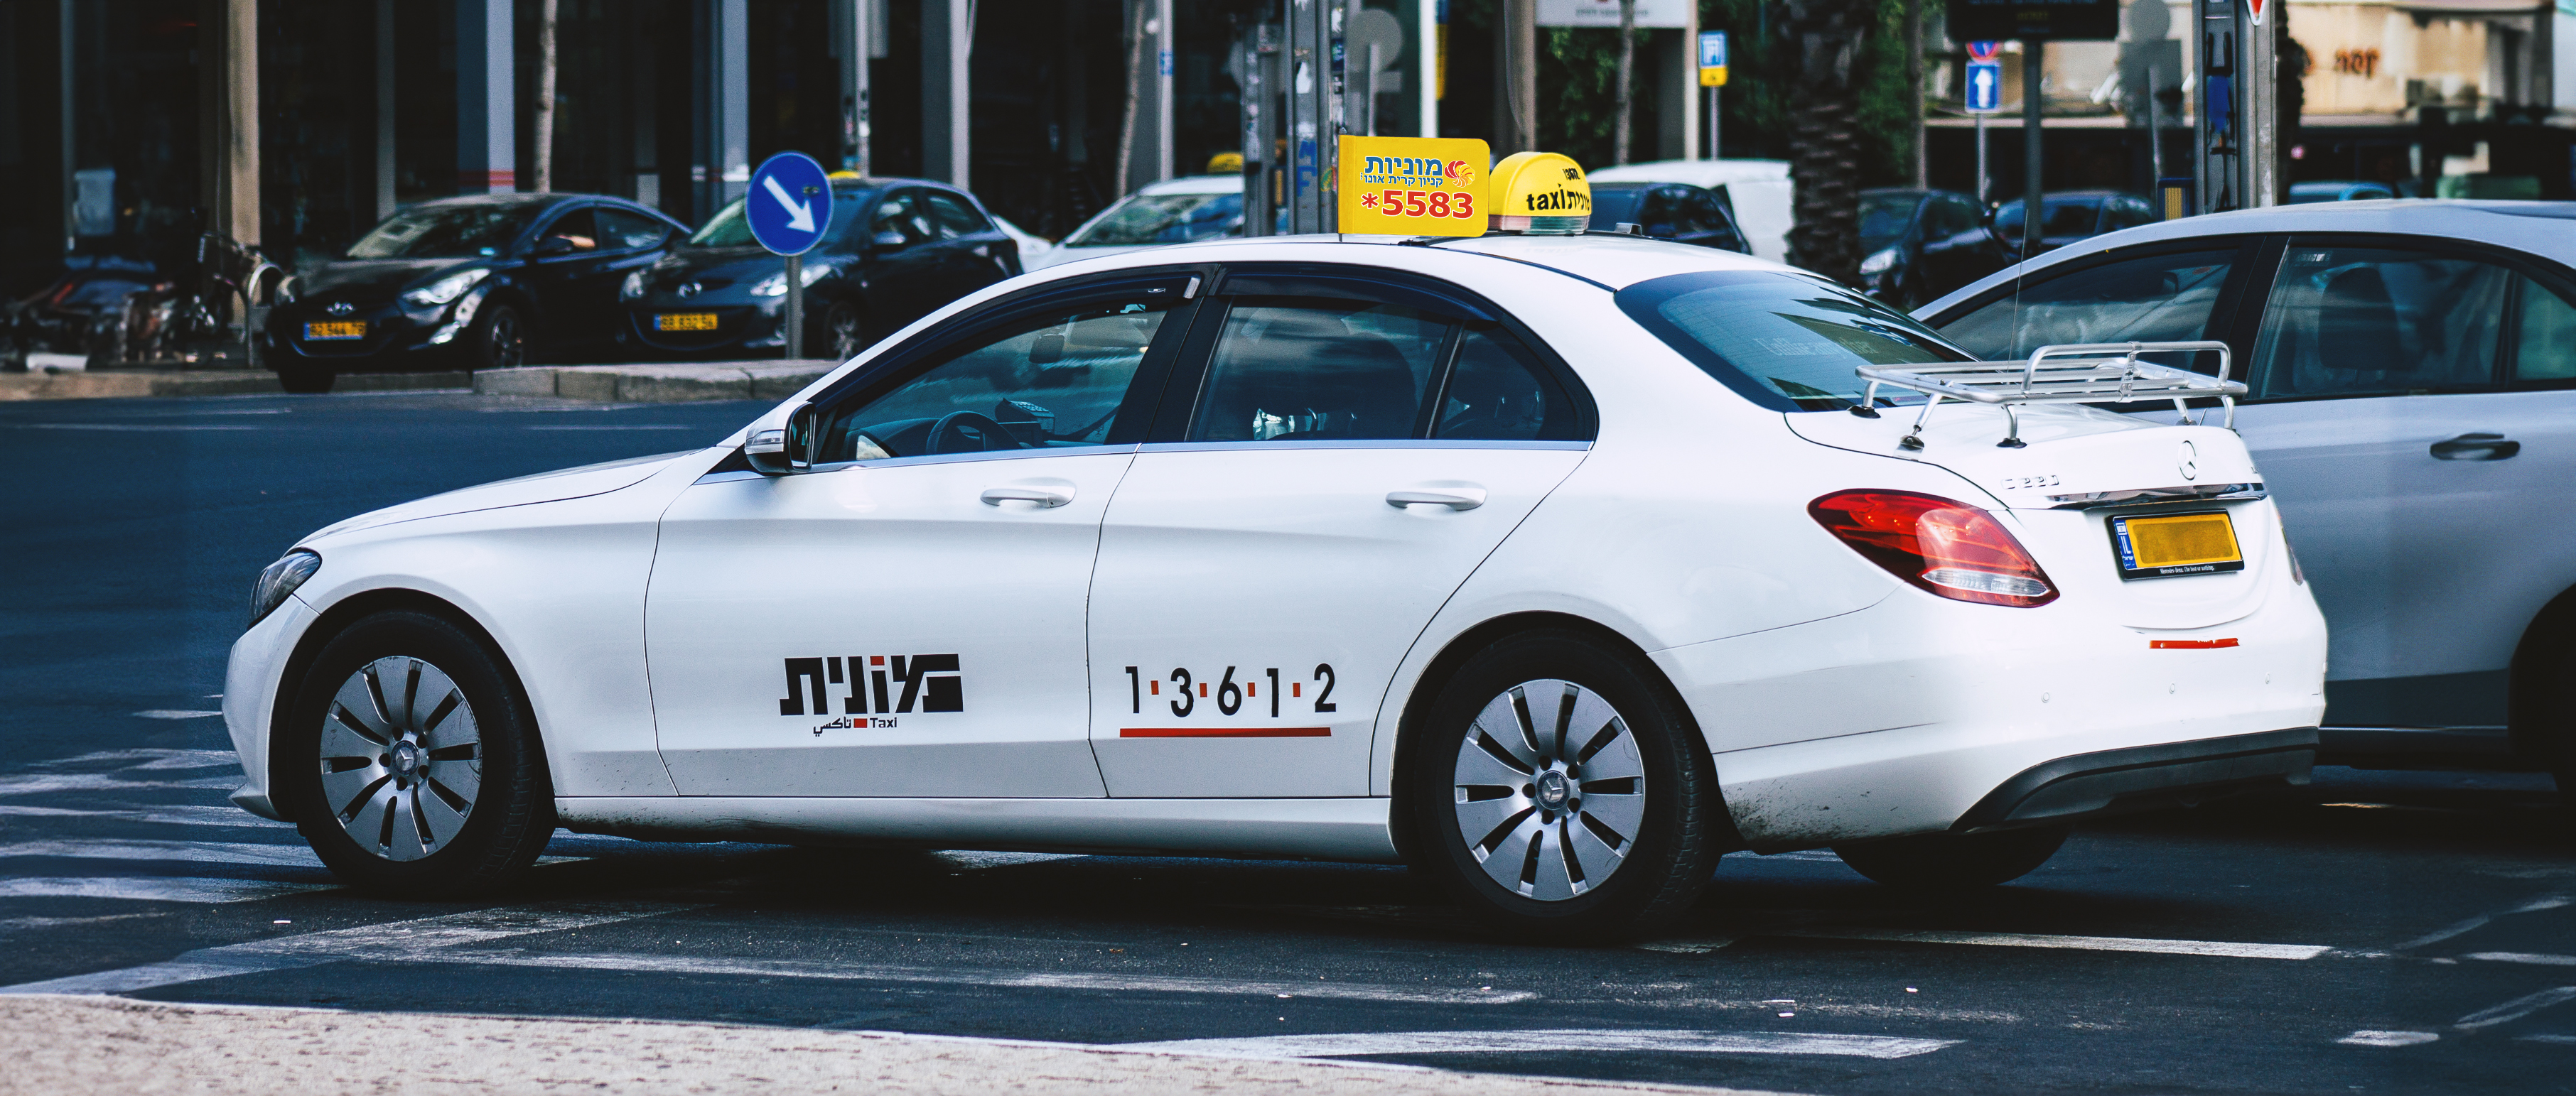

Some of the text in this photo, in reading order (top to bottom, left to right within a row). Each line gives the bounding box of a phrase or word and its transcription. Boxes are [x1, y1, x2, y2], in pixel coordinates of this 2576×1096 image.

[1364, 156, 1443, 177] מוניות
[1364, 174, 1385, 184] אונו
[1388, 175, 1416, 187] קרית
[1418, 176, 1443, 188] קניון
[1526, 183, 1565, 211] taxi
[2000, 479, 2015, 489] C
[813, 716, 851, 737] تاكسي
[870, 717, 898, 728] Taxi
